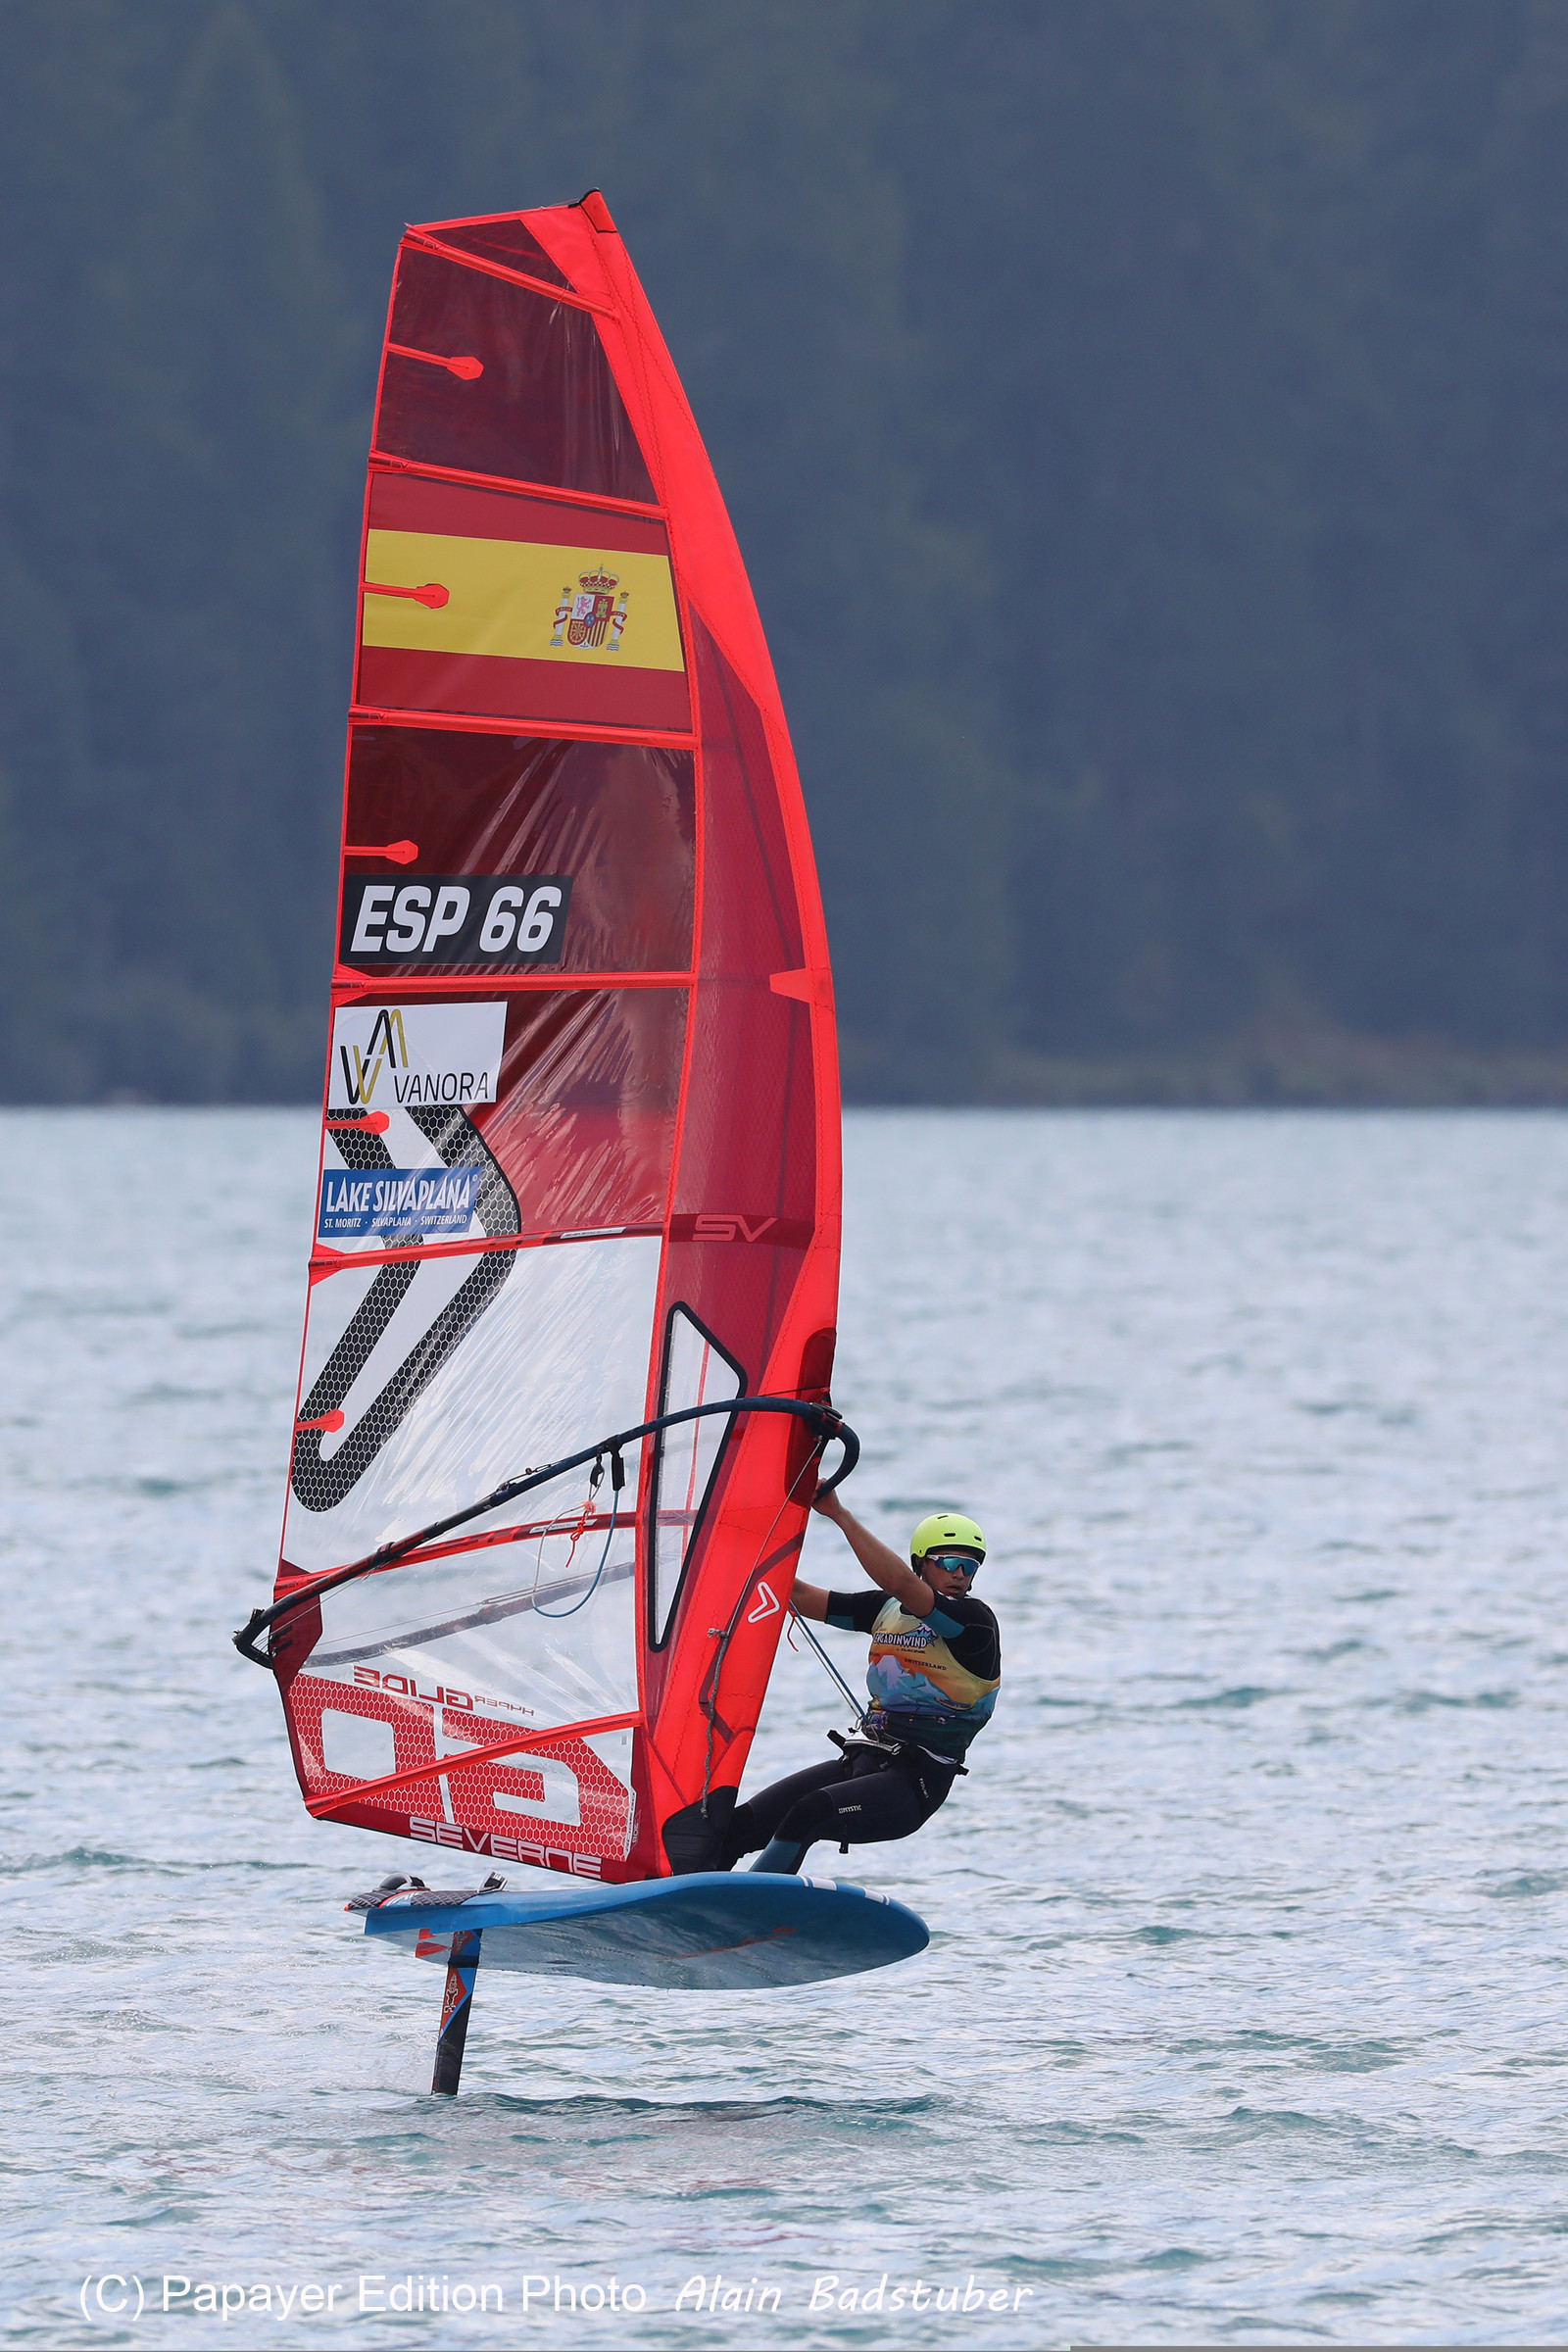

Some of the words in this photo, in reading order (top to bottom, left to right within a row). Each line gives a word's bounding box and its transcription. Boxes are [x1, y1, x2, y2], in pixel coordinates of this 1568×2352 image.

[350, 885, 470, 953] ESP
[478, 885, 563, 953] 66
[394, 1071, 489, 1103] VANORA
[326, 1176, 372, 1213] LAKE
[372, 1174, 470, 1215] SILVAPLANA
[324, 1218, 333, 1228] ST.
[334, 1217, 362, 1228] MORITZ
[371, 1216, 412, 1227] SILVAPLANA
[420, 1214, 467, 1226] SWITZERLAND
[692, 1214, 778, 1243] SV
[873, 1633, 927, 1648] ENGADINWIND
[905, 1657, 948, 1671] SWITZERLAND
[409, 1816, 602, 1879] SEVERNE
